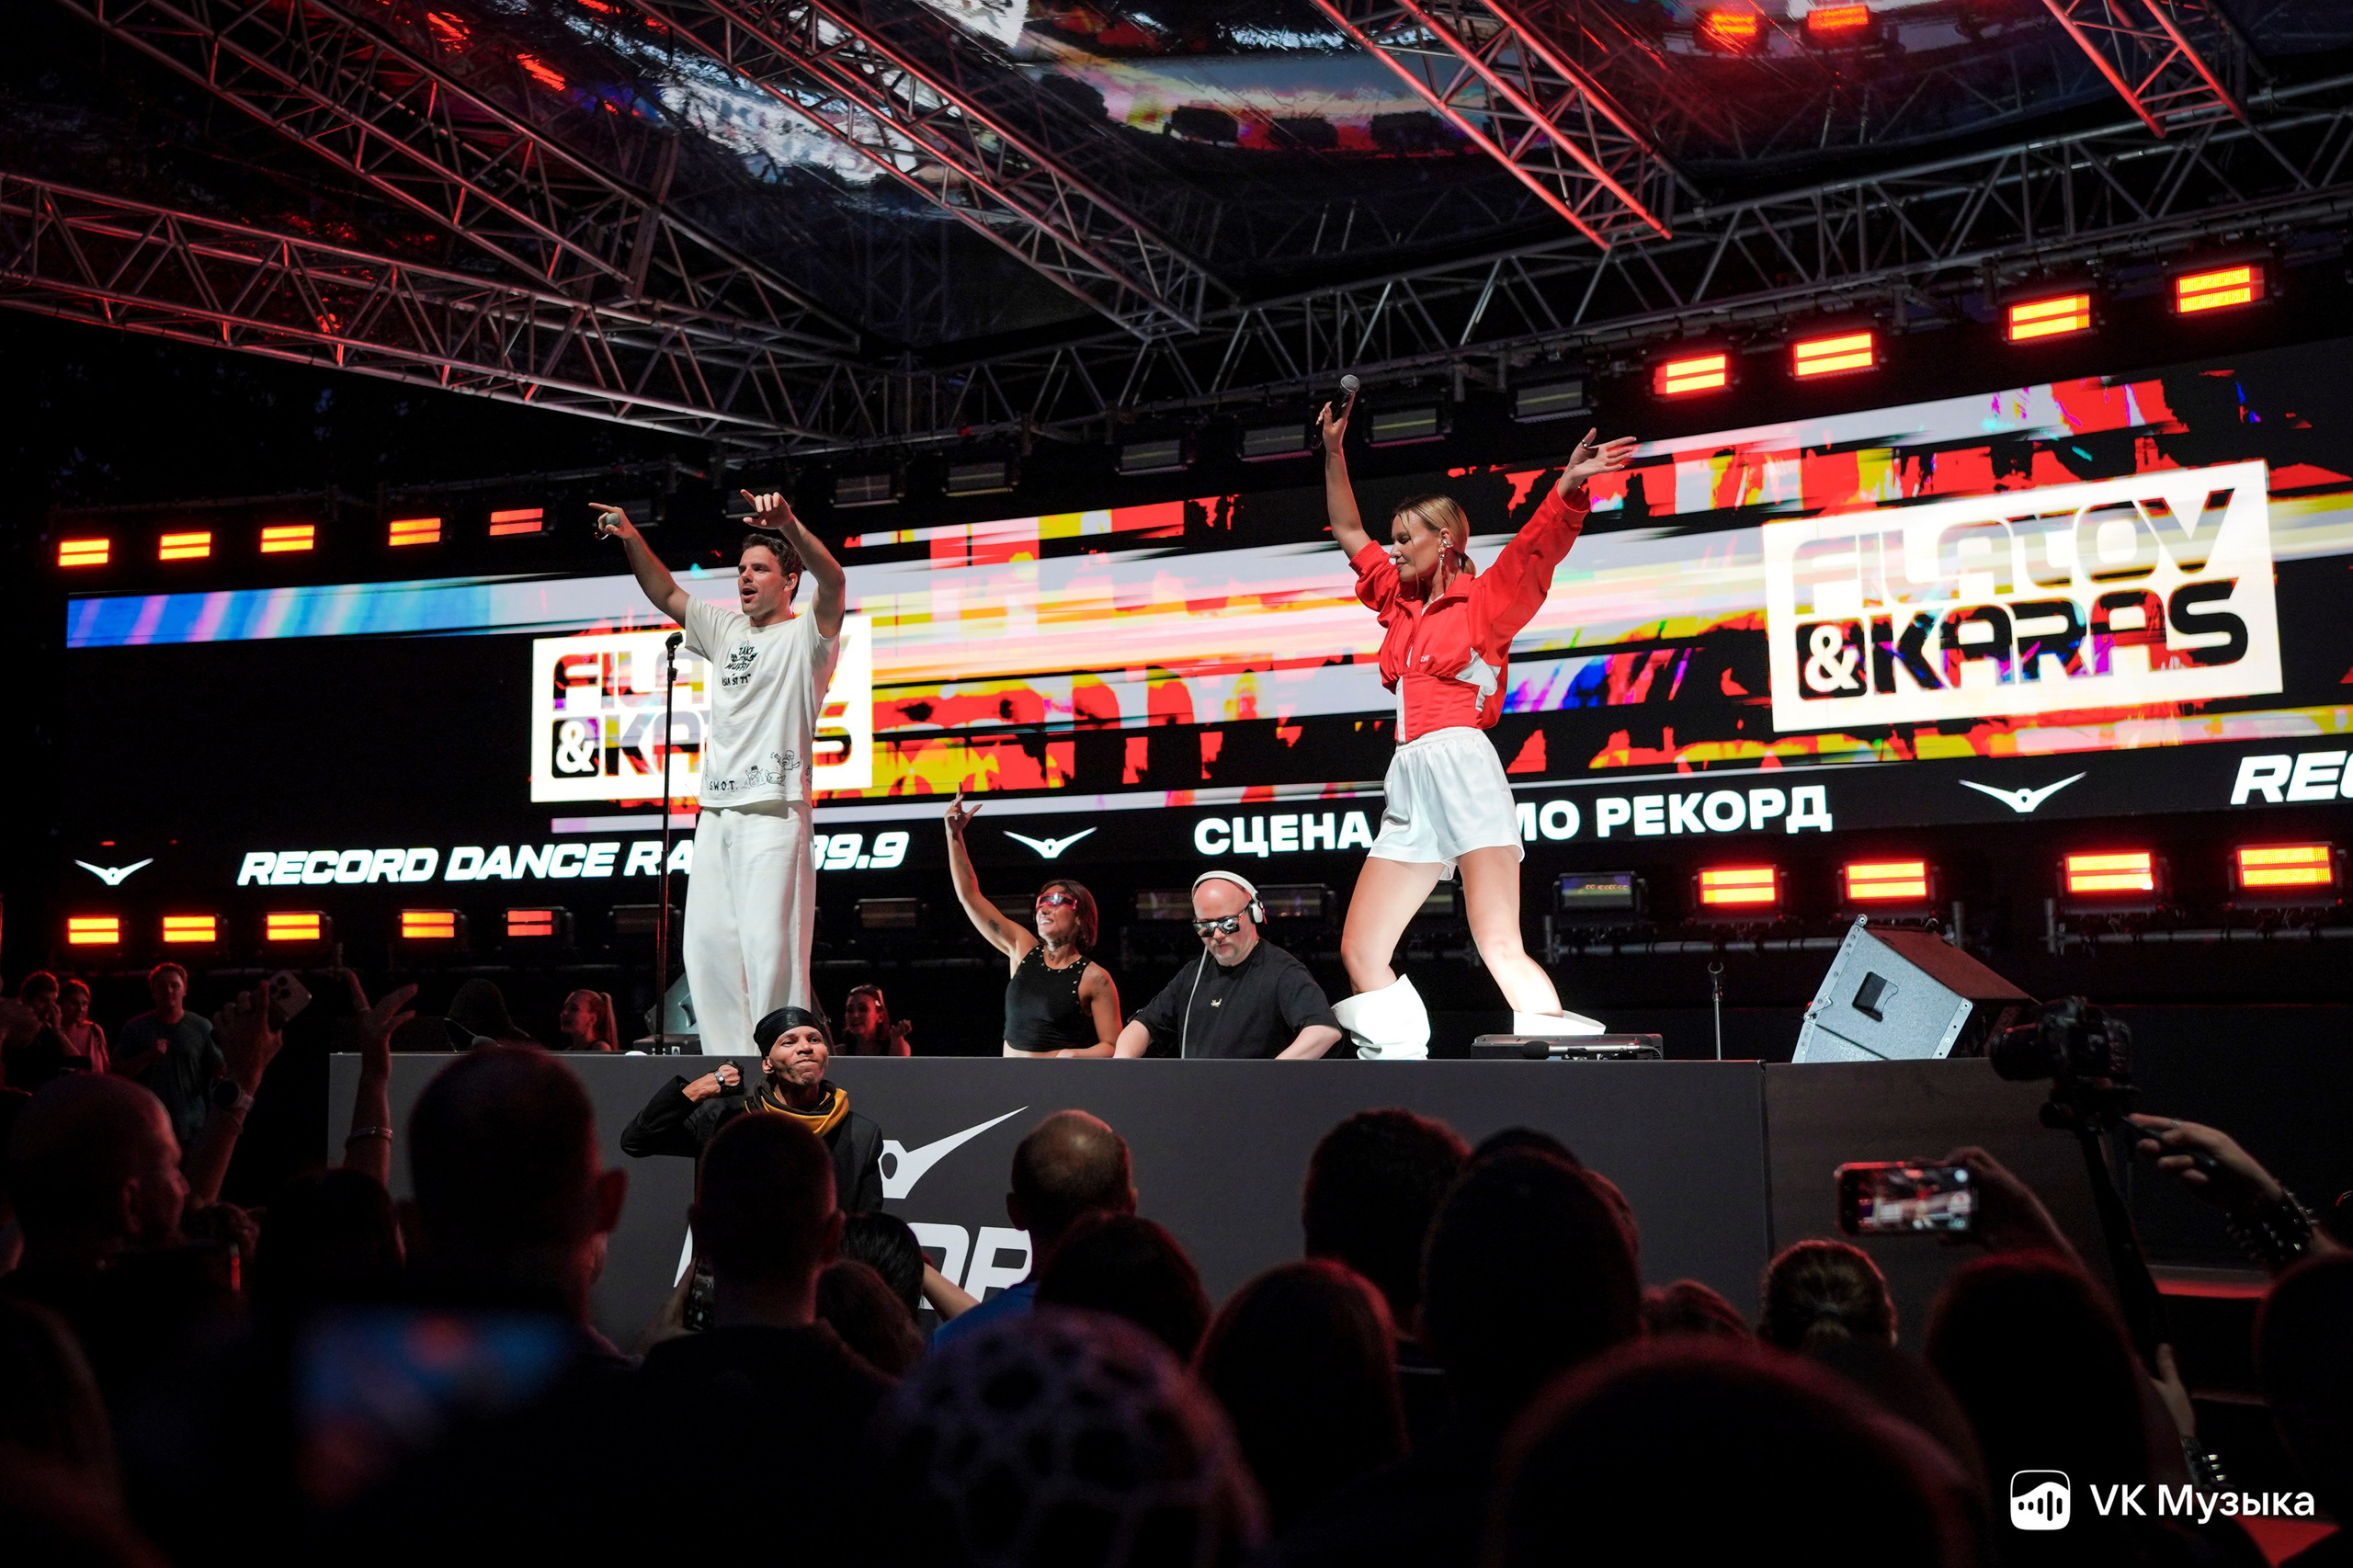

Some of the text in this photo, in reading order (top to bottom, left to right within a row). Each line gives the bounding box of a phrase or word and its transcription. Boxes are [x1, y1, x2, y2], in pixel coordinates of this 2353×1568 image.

[1792, 487, 2236, 615] FILATOV
[551, 701, 852, 778] &KAS
[1194, 811, 1374, 858] СЦЕНА
[1596, 785, 1833, 838] РЕКОРД
[237, 848, 438, 885] RECORD
[445, 843, 620, 881] DANCE
